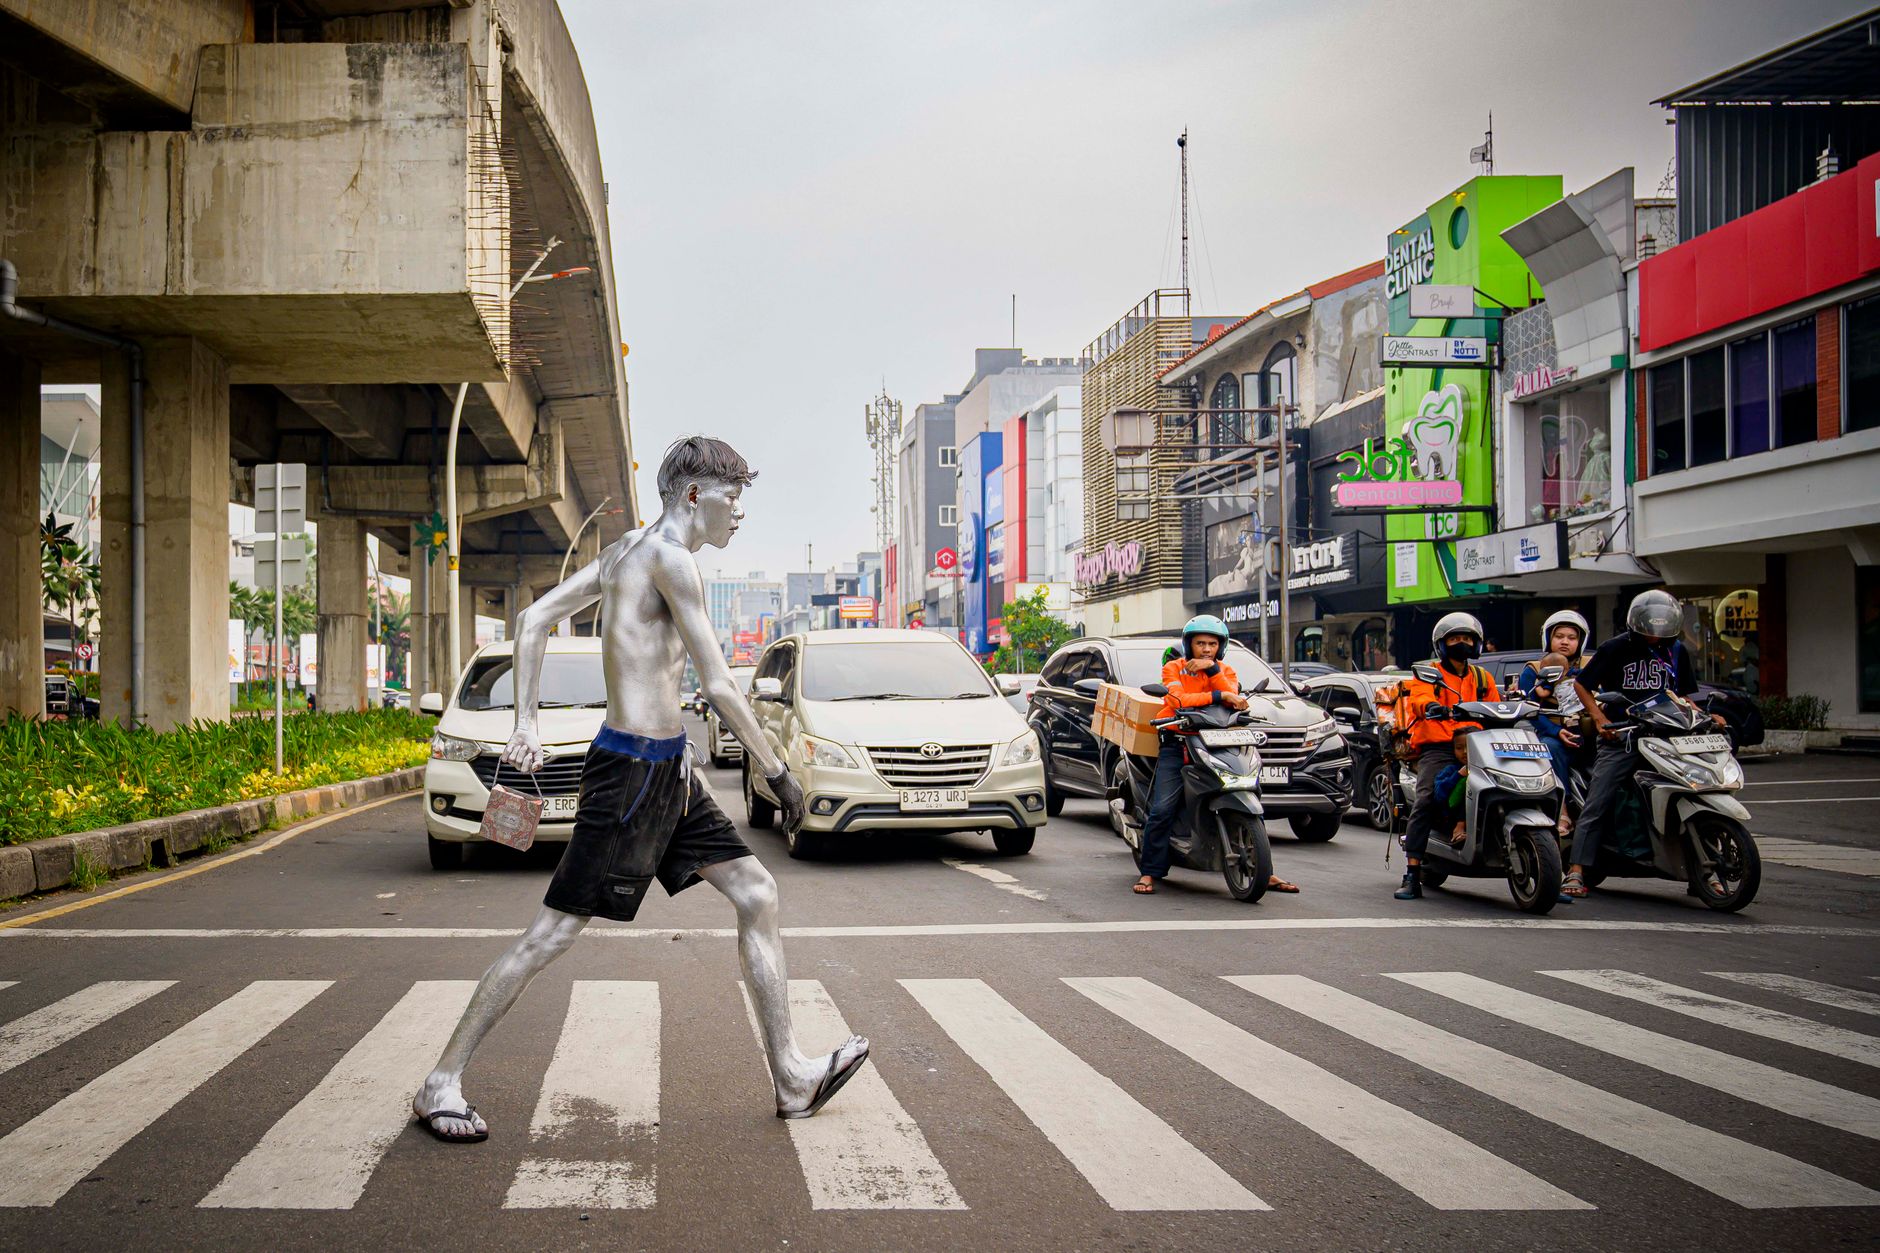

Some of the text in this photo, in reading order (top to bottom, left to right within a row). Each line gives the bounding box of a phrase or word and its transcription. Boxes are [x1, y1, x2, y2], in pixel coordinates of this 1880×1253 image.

[1385, 226, 1434, 275] DENTAL
[1385, 251, 1434, 300] CLINIC
[1454, 340, 1465, 348] BY
[1397, 348, 1438, 358] CONTRAST
[1454, 347, 1478, 355] NOTTI
[1344, 485, 1455, 502] Dental Clinic
[1521, 538, 1528, 547] BY
[1521, 546, 1539, 556] NOTTI
[1074, 541, 1141, 586] Happy Puppy
[1468, 556, 1495, 568] CONTRAST
[1725, 606, 1743, 617] BY
[1622, 659, 1672, 690] EAST
[1673, 738, 1680, 746] B
[1270, 767, 1288, 778] CIK
[903, 790, 967, 803] B 1273 URJ
[555, 799, 576, 811] ERC
